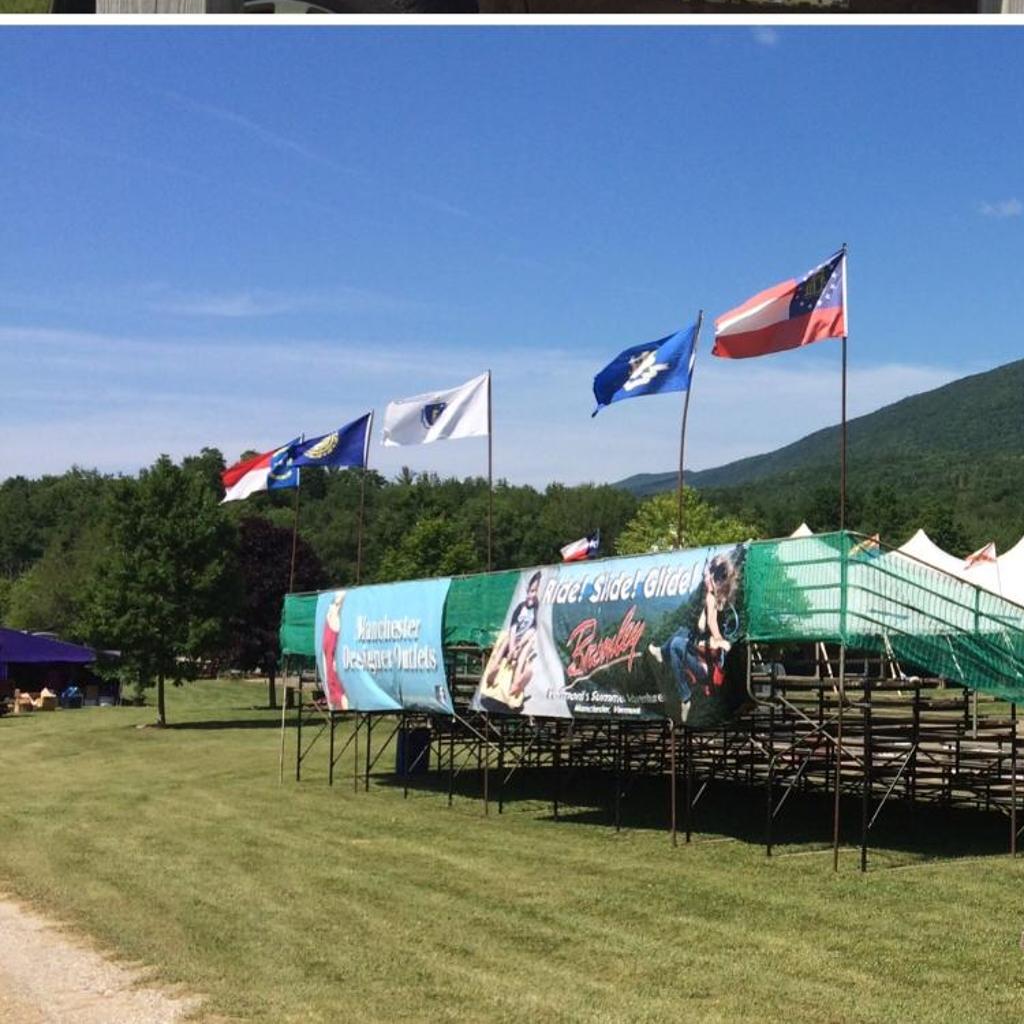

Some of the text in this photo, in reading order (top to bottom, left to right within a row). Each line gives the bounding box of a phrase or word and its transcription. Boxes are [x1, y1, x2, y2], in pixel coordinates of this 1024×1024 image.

[543, 563, 702, 604] Ride! Slide! Glide!
